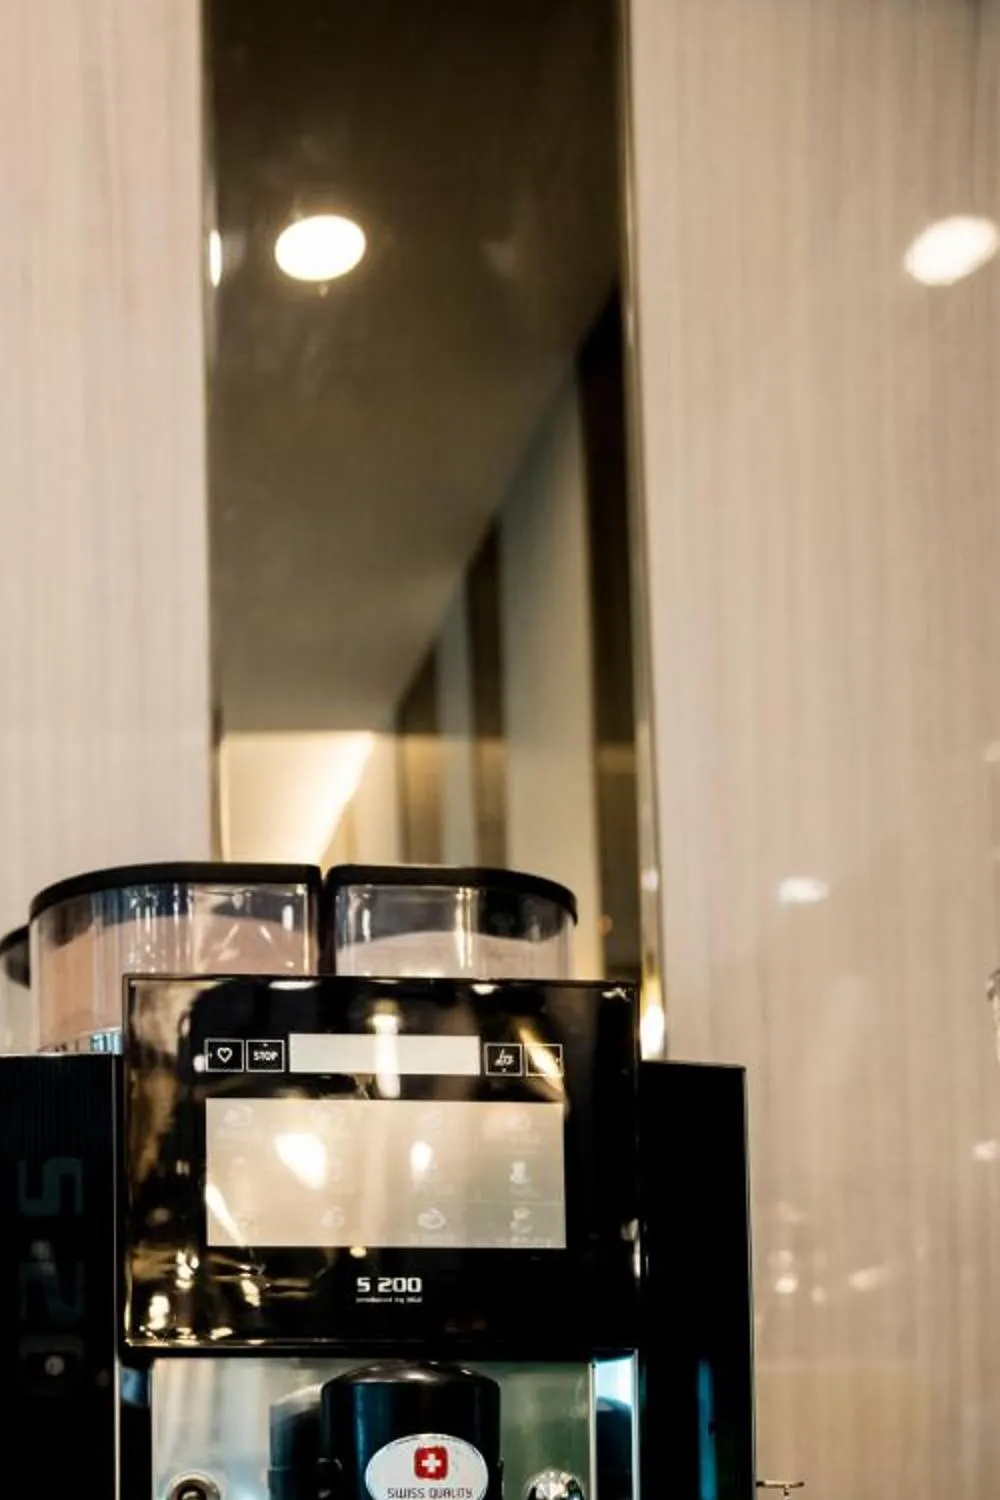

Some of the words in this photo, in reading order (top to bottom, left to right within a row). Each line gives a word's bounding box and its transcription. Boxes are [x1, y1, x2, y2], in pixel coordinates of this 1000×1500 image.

[253, 1050, 278, 1061] STOP
[356, 1277, 371, 1293] S
[377, 1277, 423, 1293] 200
[386, 1487, 426, 1499] SWISS
[428, 1487, 473, 1500] QUALITY
